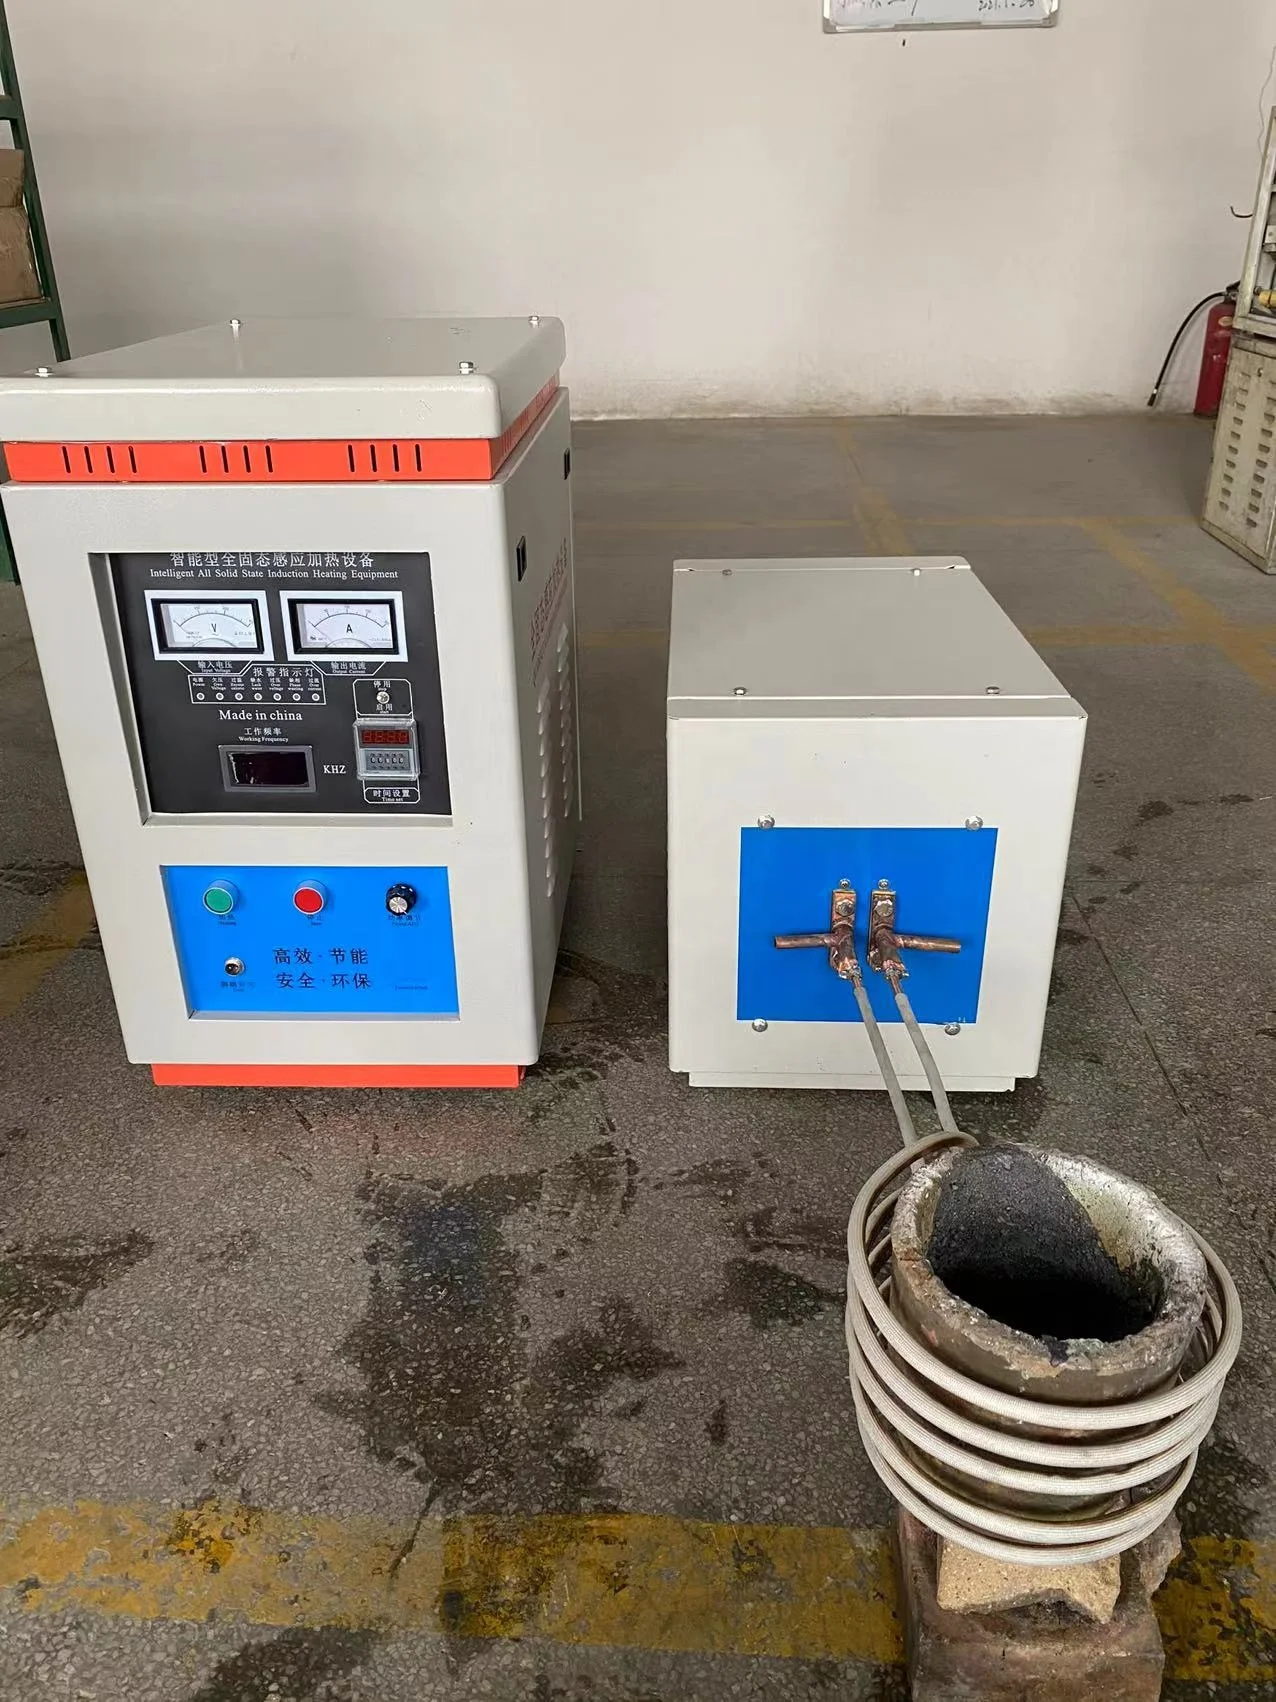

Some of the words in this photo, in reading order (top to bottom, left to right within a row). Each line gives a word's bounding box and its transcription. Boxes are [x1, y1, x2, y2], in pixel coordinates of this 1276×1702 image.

[170, 552, 374, 567] 智能型全固态感应加热设备
[150, 569, 194, 579] Intelligent
[198, 569, 211, 577] All
[215, 569, 239, 578] Solid
[241, 569, 264, 578] State
[268, 569, 309, 578] Induction
[313, 569, 347, 580] Heating
[351, 569, 398, 580] Equipment
[211, 623, 217, 632] V
[346, 624, 353, 633] A
[253, 667, 314, 677] 报警指示灯
[219, 709, 252, 720] Made
[255, 710, 267, 720] in
[269, 710, 303, 720] china
[244, 727, 281, 736] 工作频率
[323, 765, 347, 774] KHZ
[373, 789, 410, 798] 时间设置
